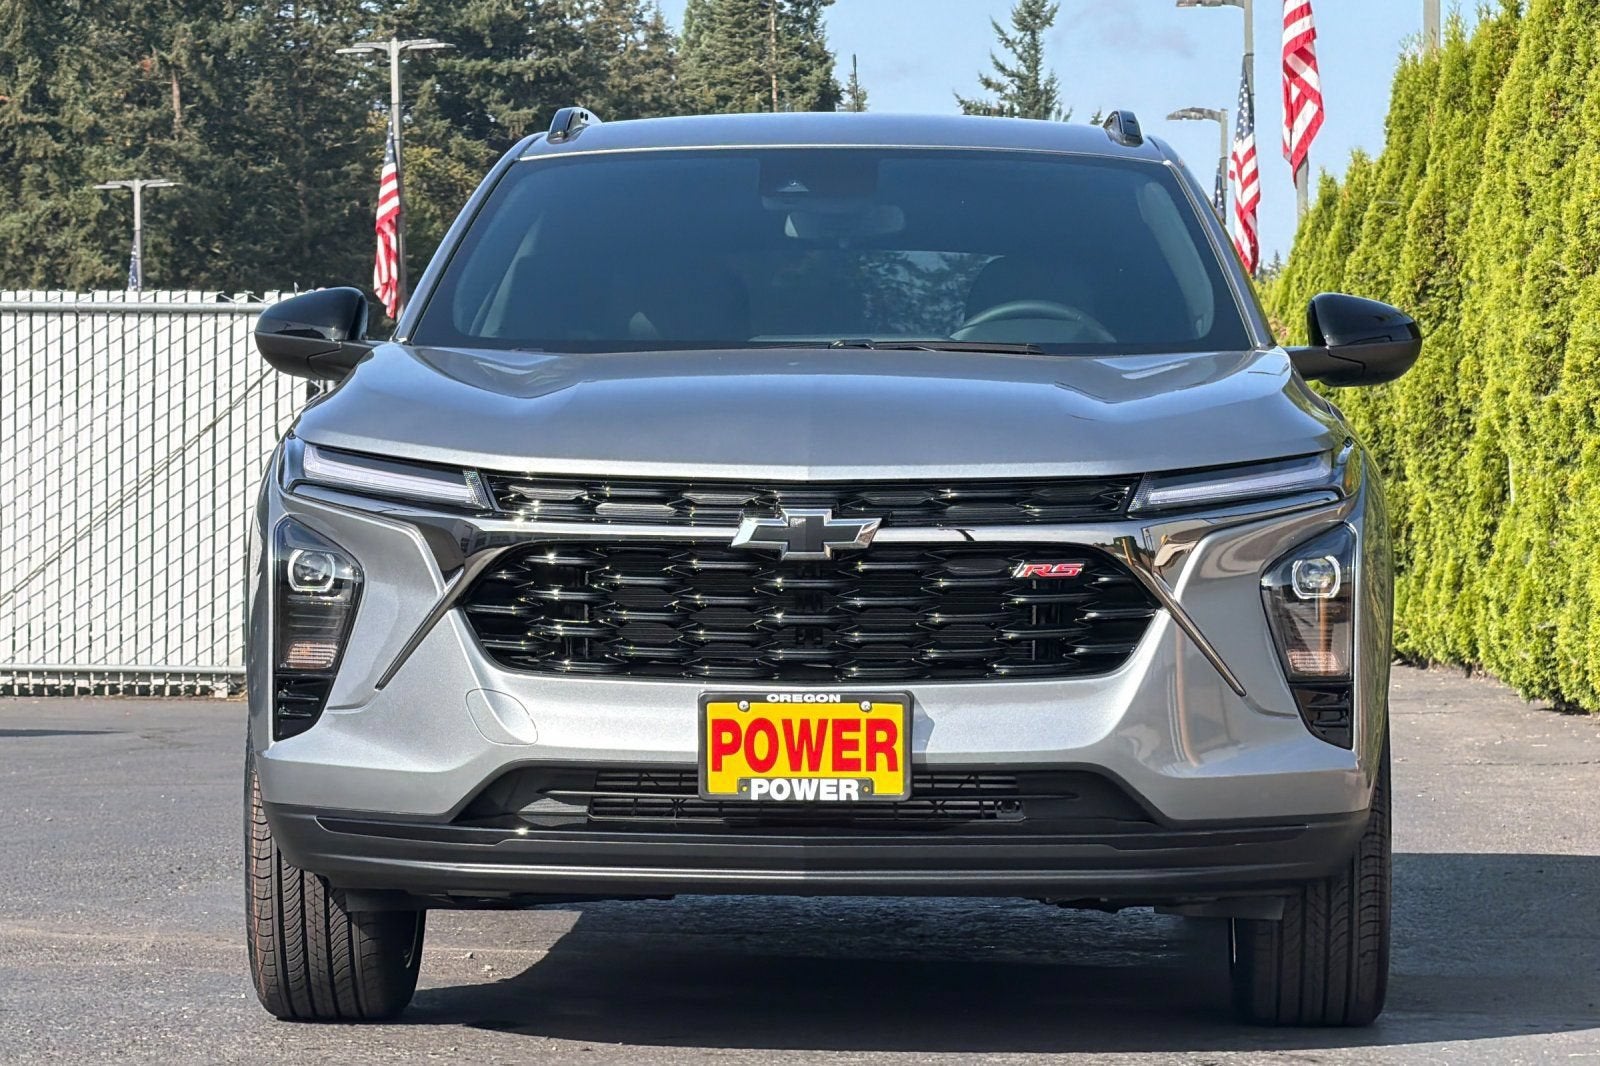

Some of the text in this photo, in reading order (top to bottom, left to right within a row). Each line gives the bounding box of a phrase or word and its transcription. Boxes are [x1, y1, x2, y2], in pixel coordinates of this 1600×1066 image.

[1015, 563, 1084, 578] RS
[766, 694, 841, 703] OREGON
[711, 717, 899, 773] POWER
[750, 778, 859, 801] POWER
